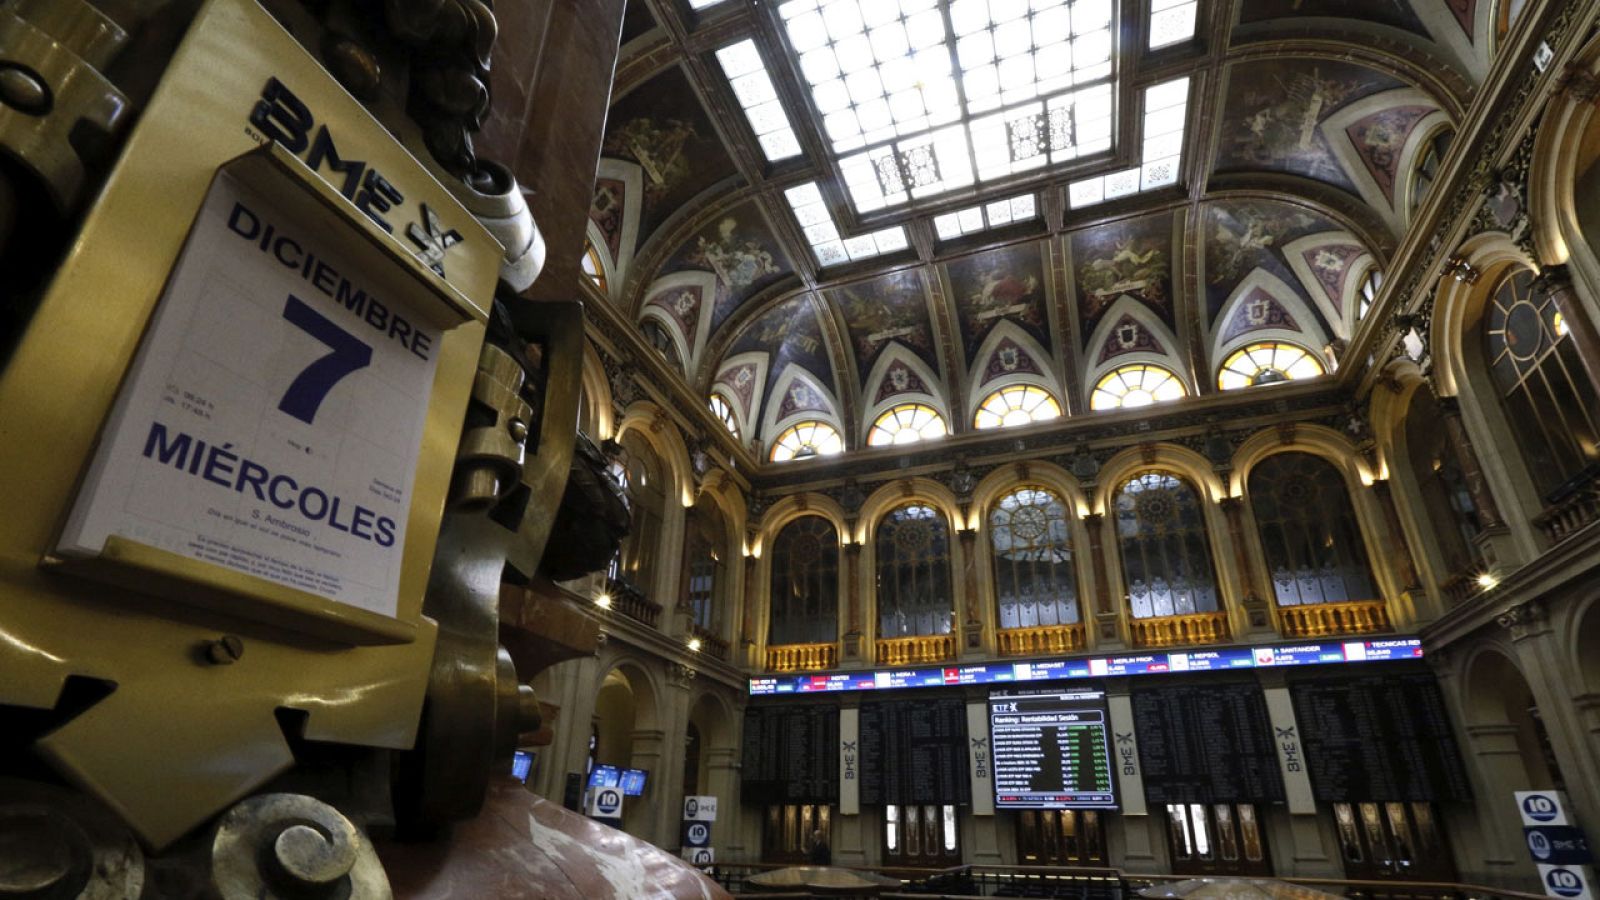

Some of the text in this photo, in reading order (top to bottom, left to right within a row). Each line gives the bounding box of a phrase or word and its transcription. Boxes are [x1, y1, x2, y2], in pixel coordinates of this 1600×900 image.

[227, 202, 432, 362] DICIEMBRE
[278, 293, 373, 425] 7
[143, 421, 397, 548] MIÉRCOLES
[264, 514, 310, 537] Ambrosio
[1280, 646, 1320, 654] SANTANDER
[602, 793, 616, 806] 10
[1528, 798, 1552, 812] 10
[693, 828, 705, 838] 10
[1531, 834, 1547, 848] 10
[1552, 871, 1577, 887] 10
